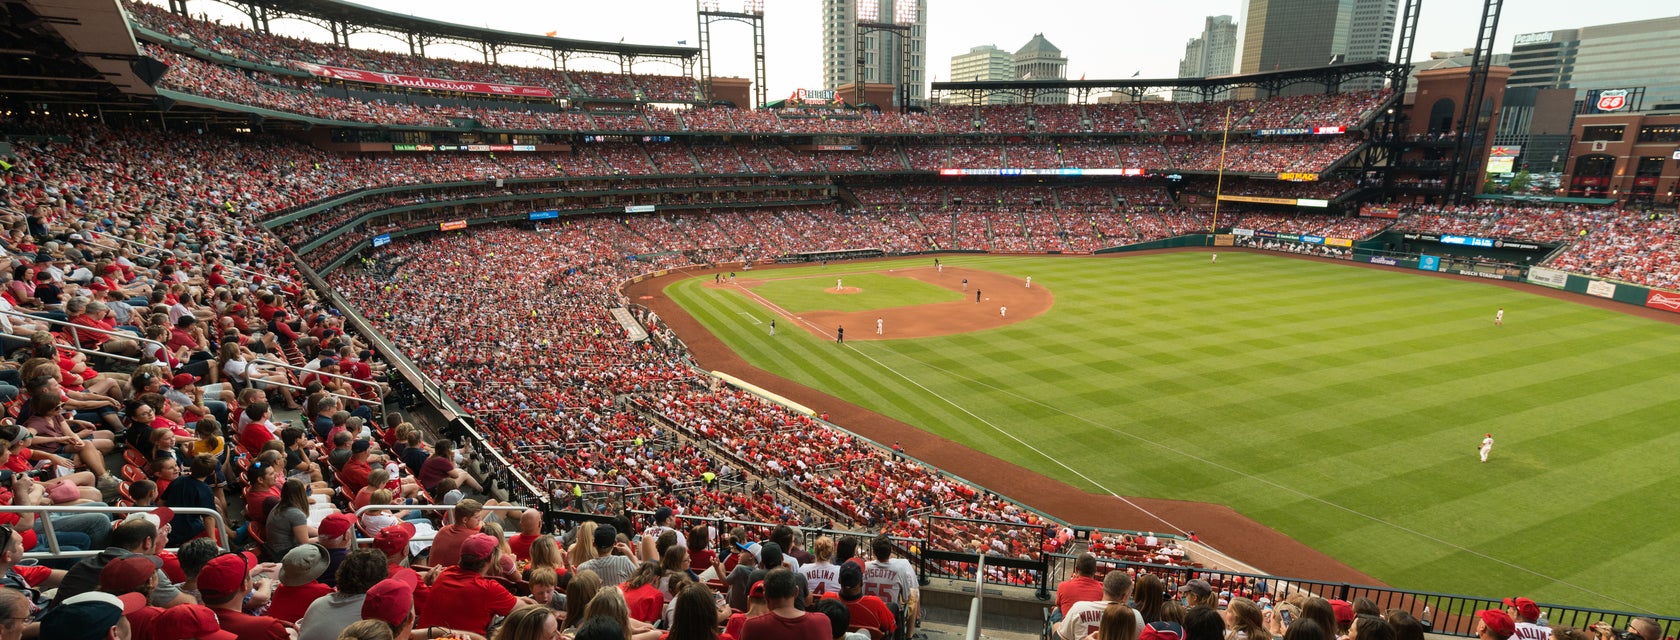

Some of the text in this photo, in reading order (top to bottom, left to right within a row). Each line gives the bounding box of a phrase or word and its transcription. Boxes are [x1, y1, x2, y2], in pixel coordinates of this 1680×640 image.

[1515, 31, 1553, 44] Peabody
[383, 73, 475, 91] Budweiser
[1601, 96, 1621, 107] 66
[1295, 173, 1314, 181] MAC
[1479, 271, 1504, 280] STADIUM
[806, 569, 835, 581] MOLINA
[864, 568, 898, 581] PISCOTTY
[1079, 610, 1104, 624] WAIN
[1515, 627, 1552, 640] MOLIN
